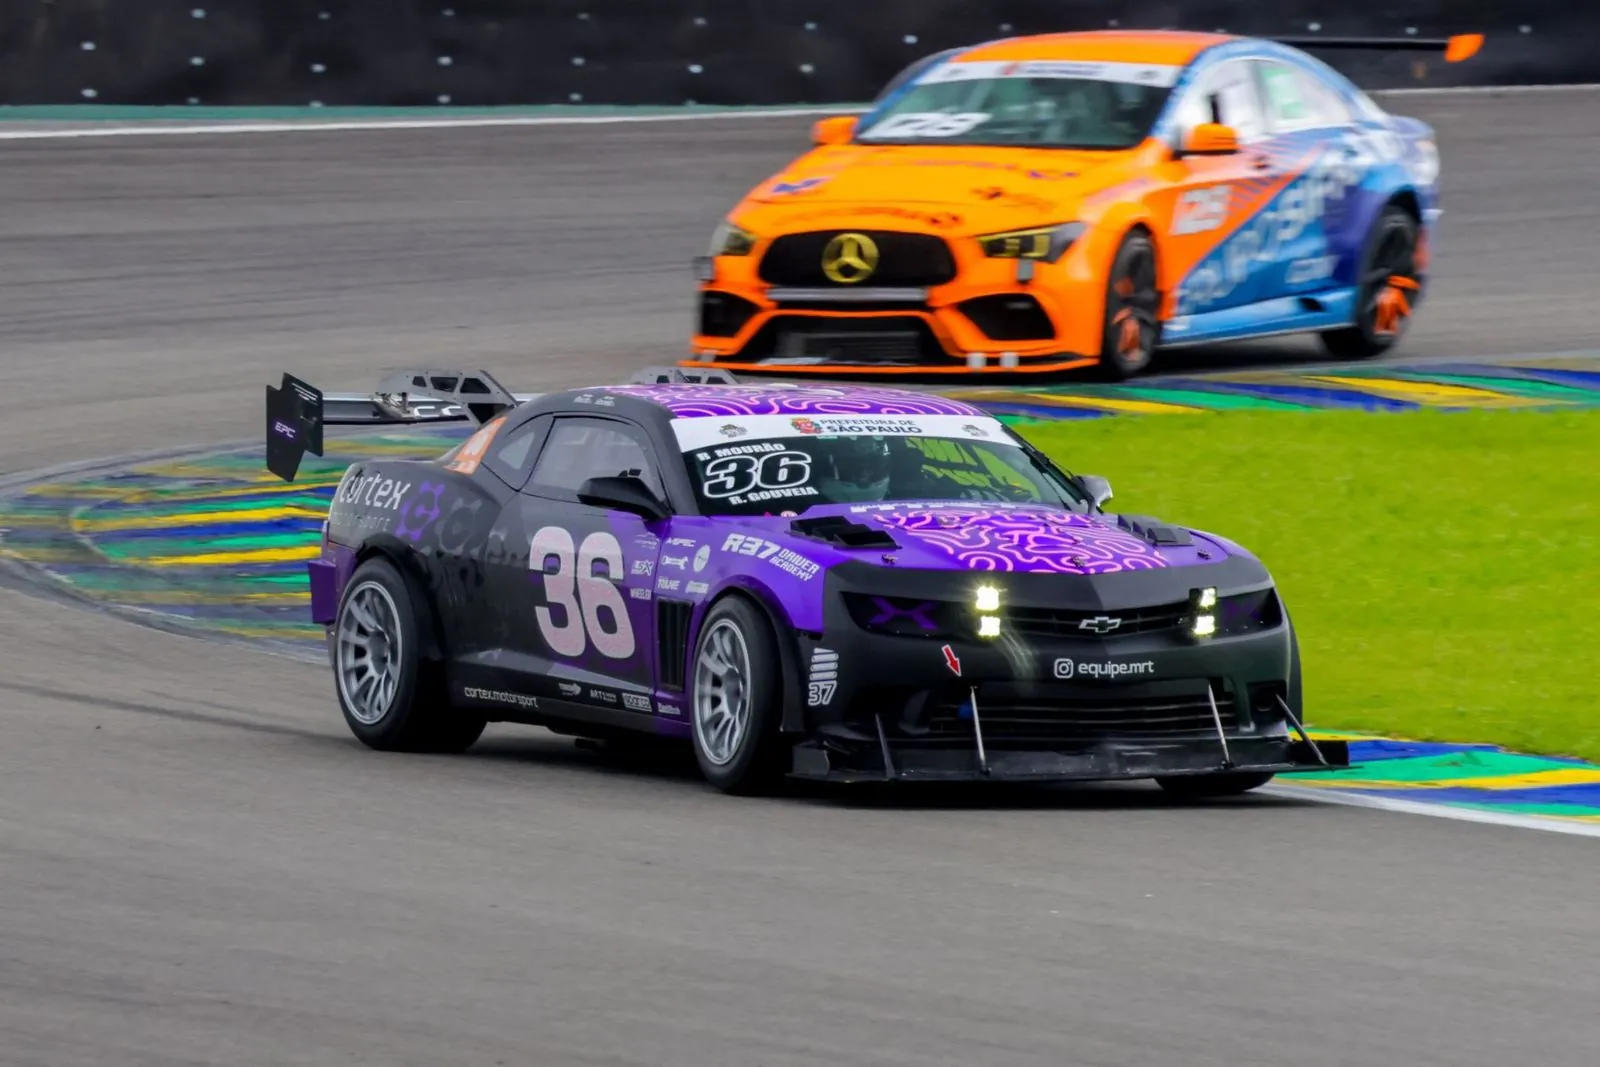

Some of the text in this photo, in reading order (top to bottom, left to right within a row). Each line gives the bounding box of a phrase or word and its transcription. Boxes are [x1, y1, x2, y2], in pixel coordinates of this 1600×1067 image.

[865, 425, 923, 434] PAULO
[714, 442, 786, 458] MOURÃO
[703, 450, 812, 498] 36
[339, 472, 412, 511] cortex
[728, 486, 819, 505] R. GOUVEIA
[721, 532, 782, 559] R37
[768, 556, 813, 582] ACADEMY
[778, 548, 820, 575] DRIVER
[529, 525, 636, 659] 36
[1078, 660, 1154, 679] equipe.mrt
[464, 686, 539, 708] cortex.motorsport
[807, 680, 838, 706] 37
